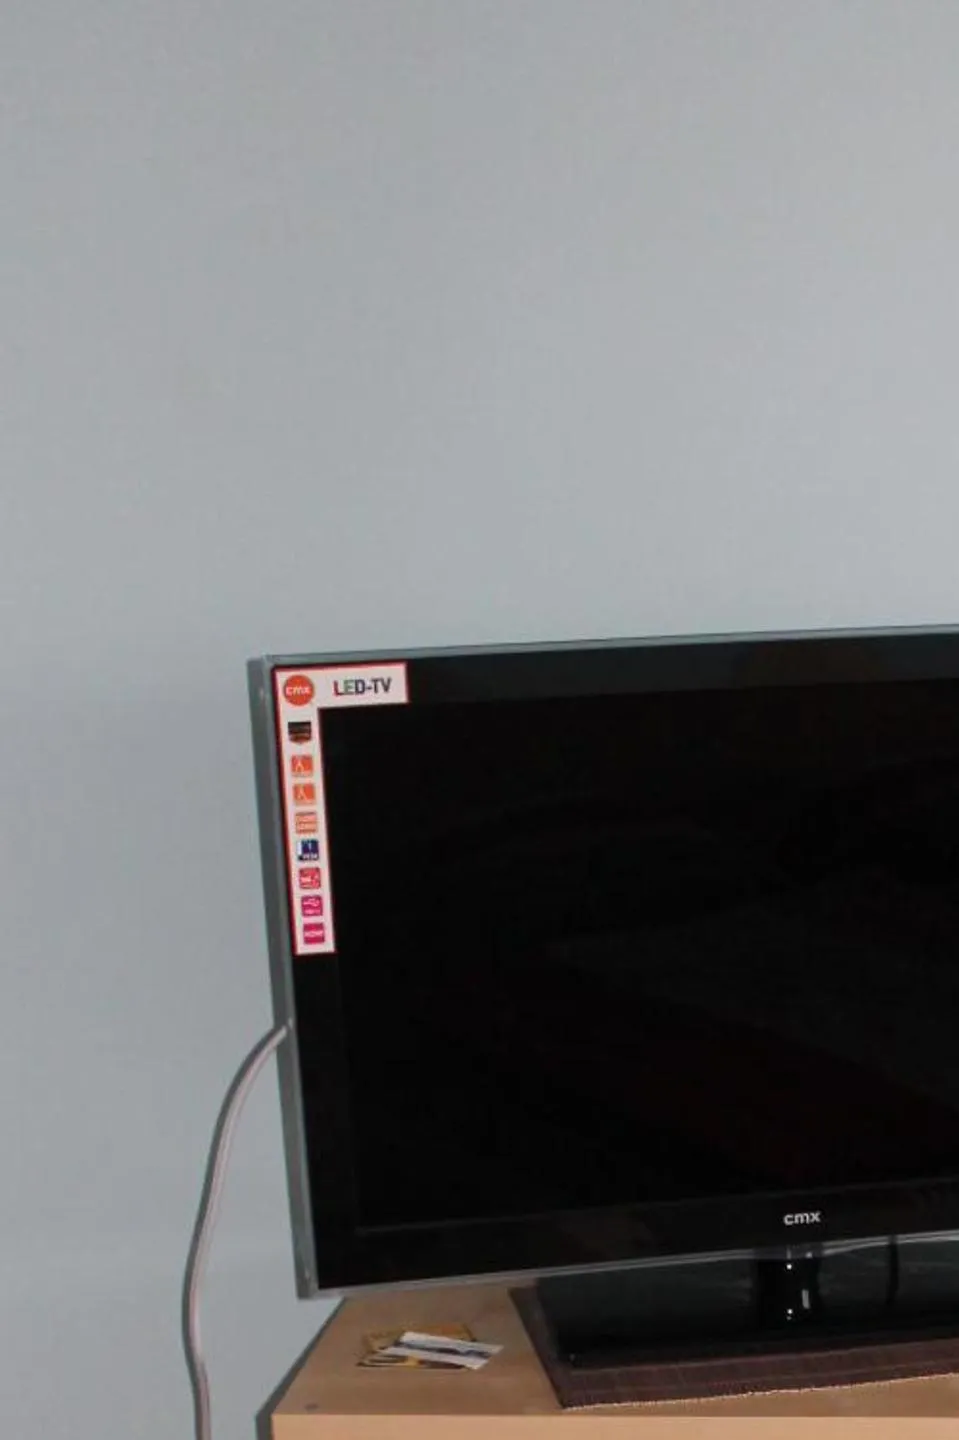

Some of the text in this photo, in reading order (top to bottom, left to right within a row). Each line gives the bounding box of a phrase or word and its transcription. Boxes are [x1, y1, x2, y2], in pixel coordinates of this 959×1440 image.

[286, 686, 310, 696] cmx
[333, 677, 392, 697] LED-TV
[783, 1211, 821, 1226] cmx
